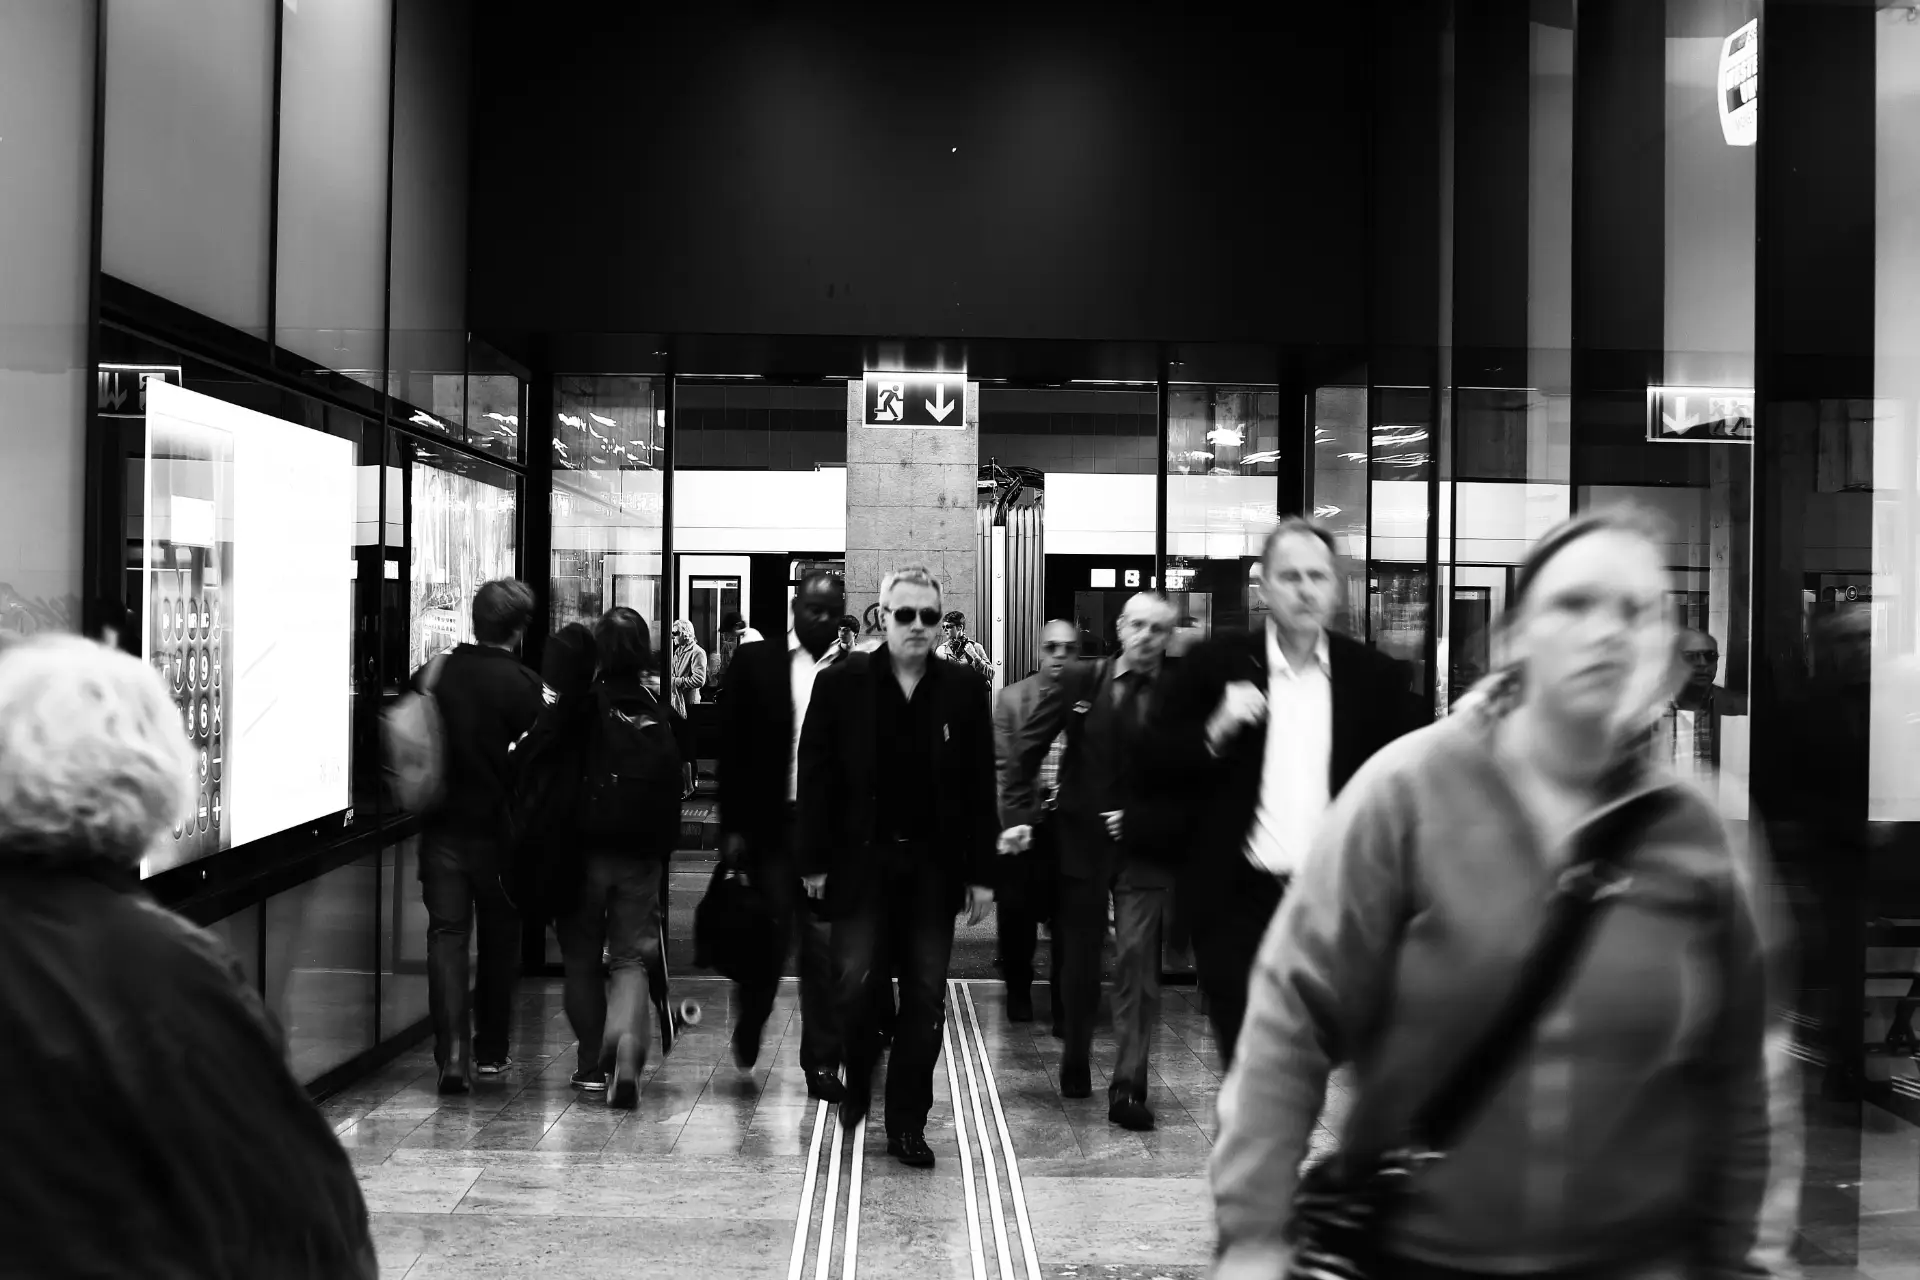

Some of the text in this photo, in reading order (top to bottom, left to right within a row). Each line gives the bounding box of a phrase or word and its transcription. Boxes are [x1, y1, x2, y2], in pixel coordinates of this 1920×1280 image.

[175, 658, 182, 684] 7
[188, 656, 197, 682] 8
[201, 655, 208, 681] 9
[188, 705, 195, 731] 5
[200, 703, 208, 729] 6
[201, 751, 208, 777] 3
